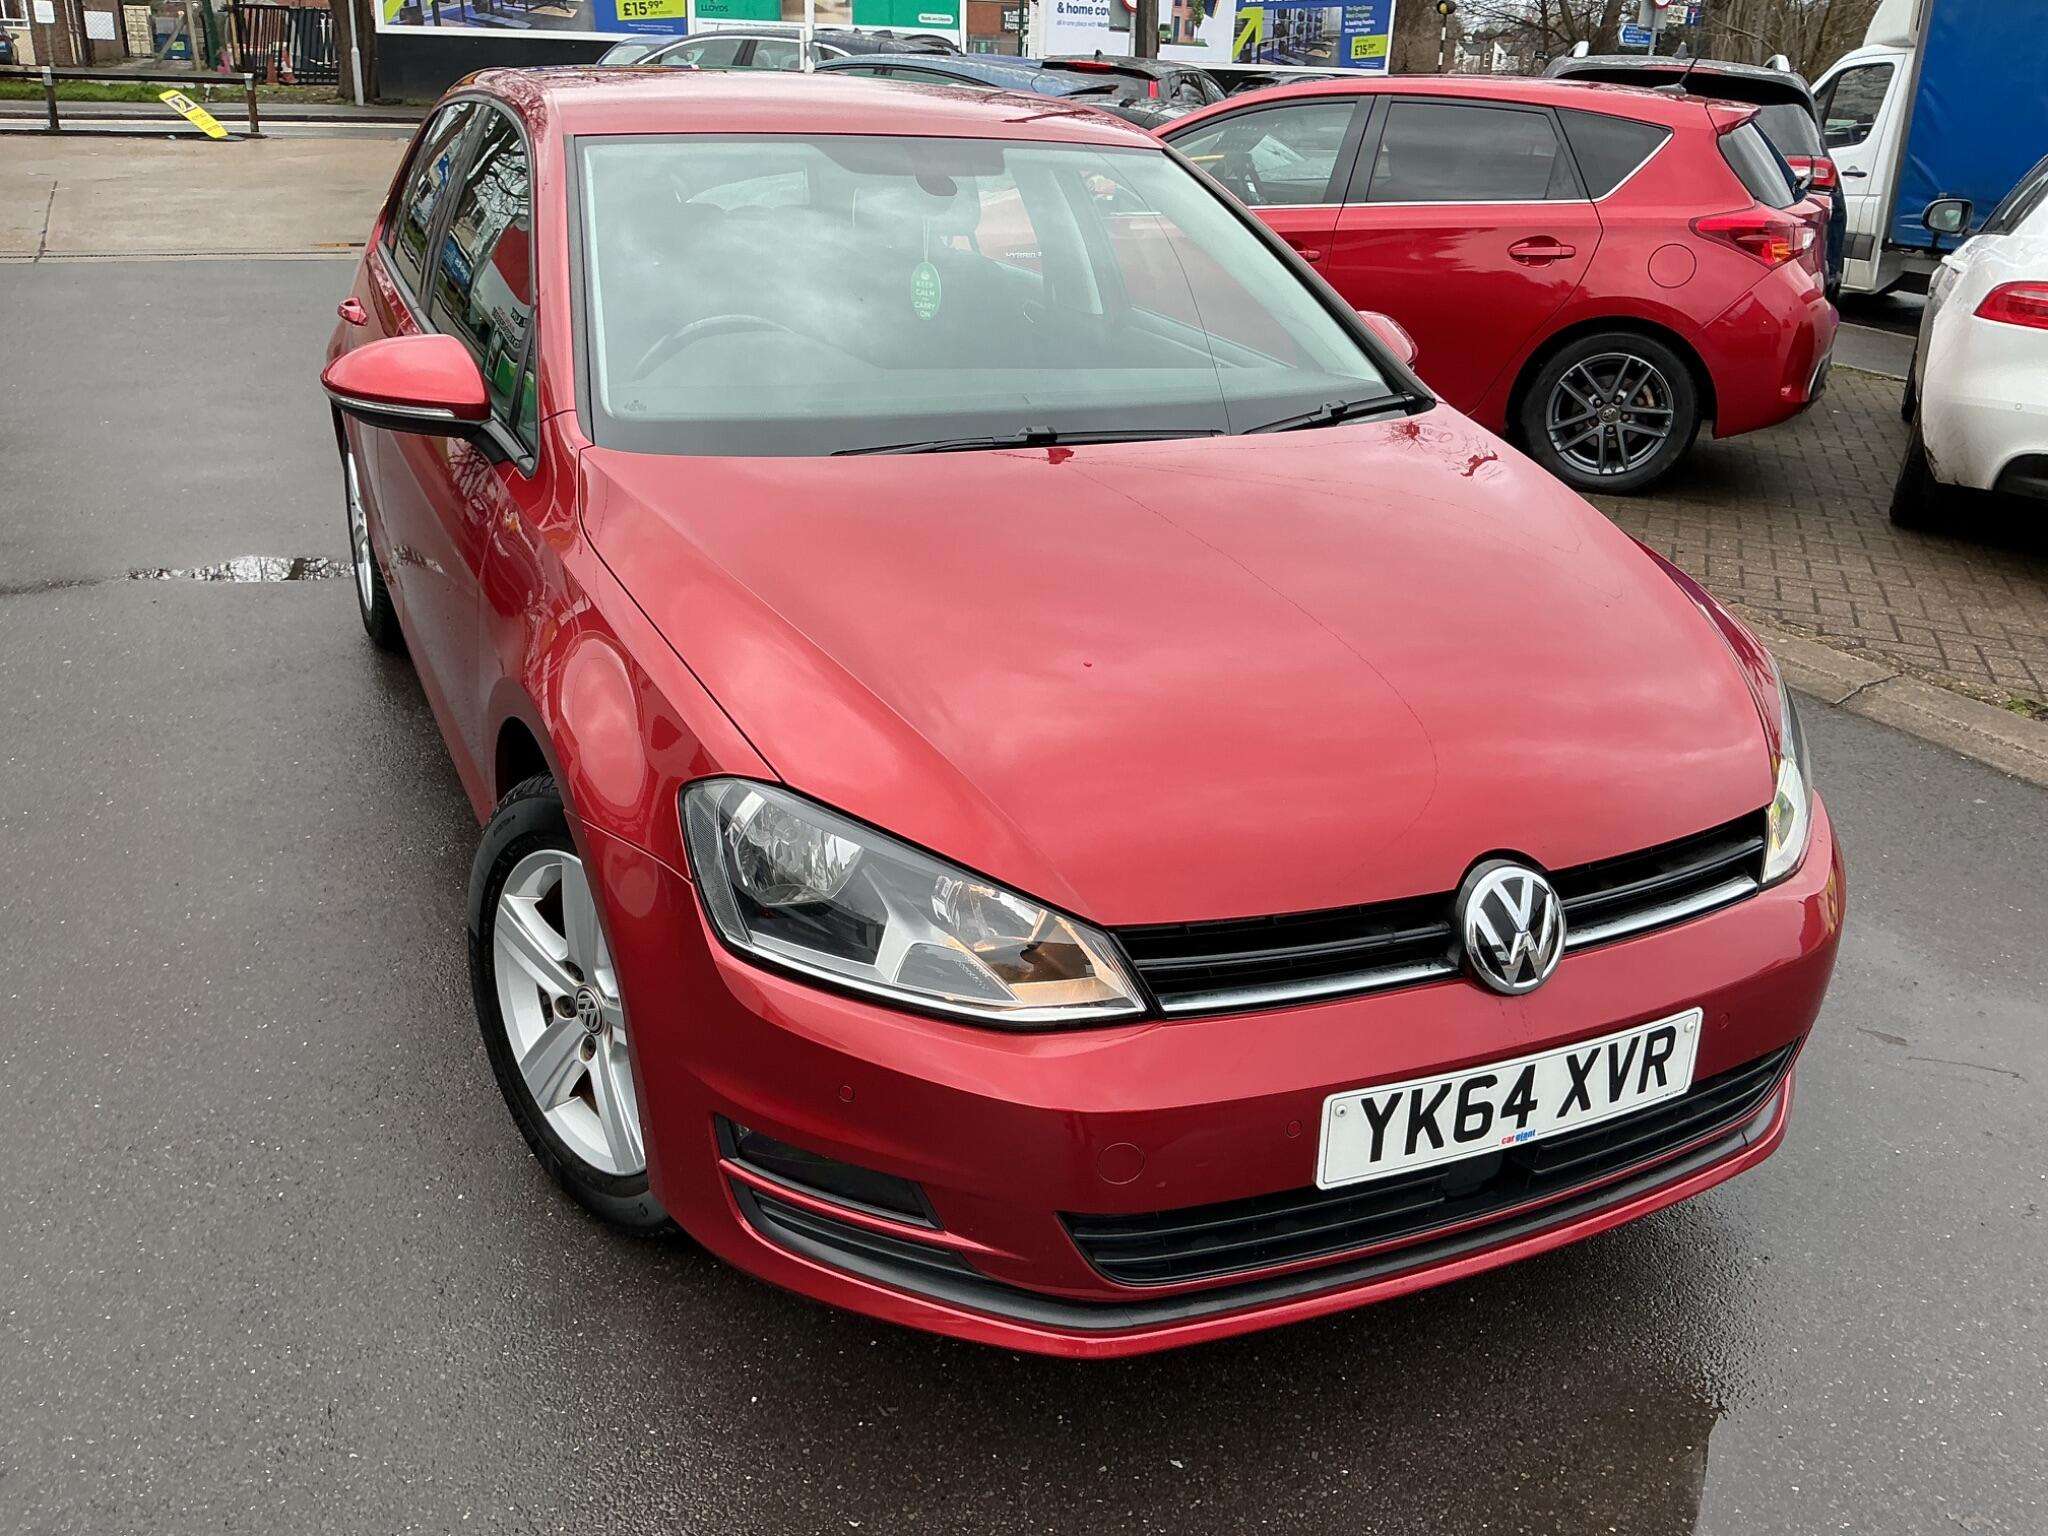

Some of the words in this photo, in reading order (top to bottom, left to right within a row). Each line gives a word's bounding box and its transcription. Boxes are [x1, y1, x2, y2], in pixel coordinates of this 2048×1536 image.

[701, 4, 729, 12] LLOYDS
[1057, 2, 1064, 13] &
[1066, 3, 1093, 15] home
[916, 288, 935, 296] CALM
[914, 301, 936, 311] CARRY
[919, 310, 931, 318] ON
[1360, 1064, 1538, 1163] YK64
[1556, 1025, 1677, 1118] XVR
